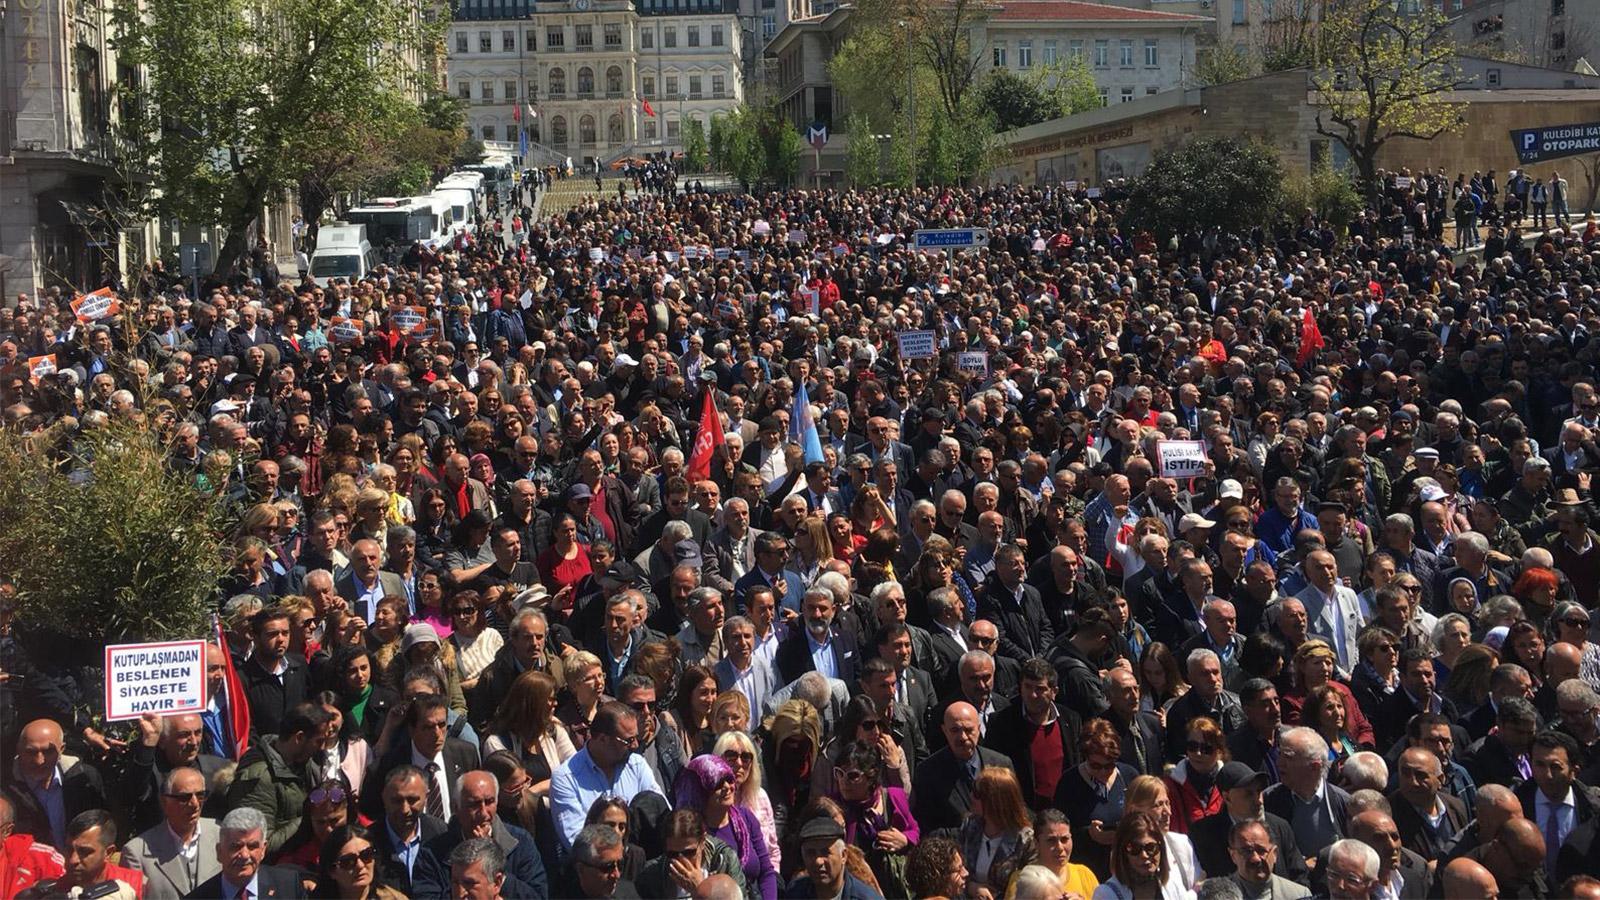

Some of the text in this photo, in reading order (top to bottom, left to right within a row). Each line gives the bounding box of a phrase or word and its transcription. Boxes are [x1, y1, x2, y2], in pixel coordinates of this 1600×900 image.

[1543, 126, 1584, 140] KULEDİBİ
[1524, 133, 1535, 149] P
[1543, 138, 1600, 151] OTOPARK
[1165, 458, 1205, 470] İSTİFA
[114, 649, 199, 668] KUTUPLAŞMADAN
[116, 667, 191, 683] BESLENEN
[120, 682, 188, 698] SİYASETE
[131, 698, 174, 712] HAYIR
